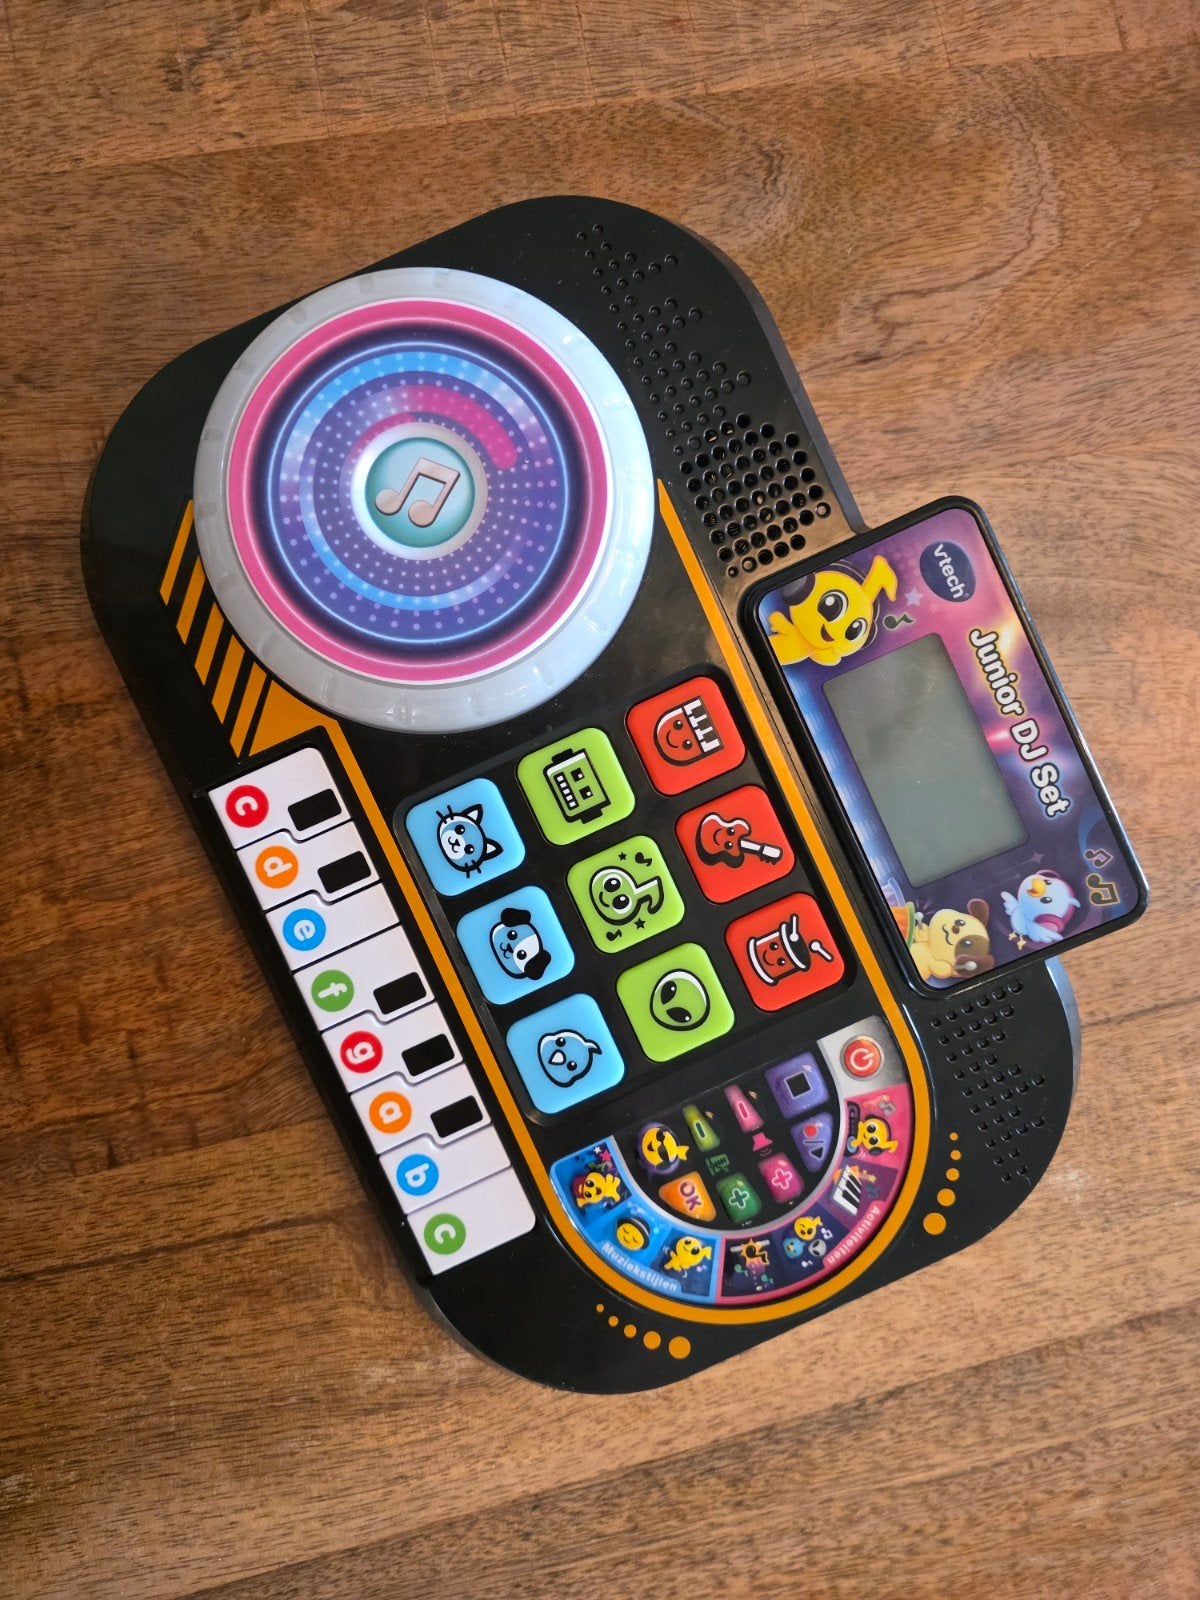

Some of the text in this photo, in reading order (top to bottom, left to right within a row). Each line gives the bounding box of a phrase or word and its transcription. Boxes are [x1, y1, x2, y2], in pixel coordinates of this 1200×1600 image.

[934, 543, 966, 599] vtech
[969, 629, 1070, 818] Junior DJ Set
[235, 796, 258, 817] c
[263, 856, 293, 878] d
[293, 919, 316, 942] e
[317, 982, 348, 999] f
[346, 1041, 376, 1065] g
[378, 1101, 403, 1124] a
[405, 1163, 430, 1188] b
[679, 1180, 703, 1212] OK
[434, 1223, 456, 1244] c
[827, 1205, 881, 1265] Activiteiten
[602, 1242, 678, 1293] Muziekstijlen
